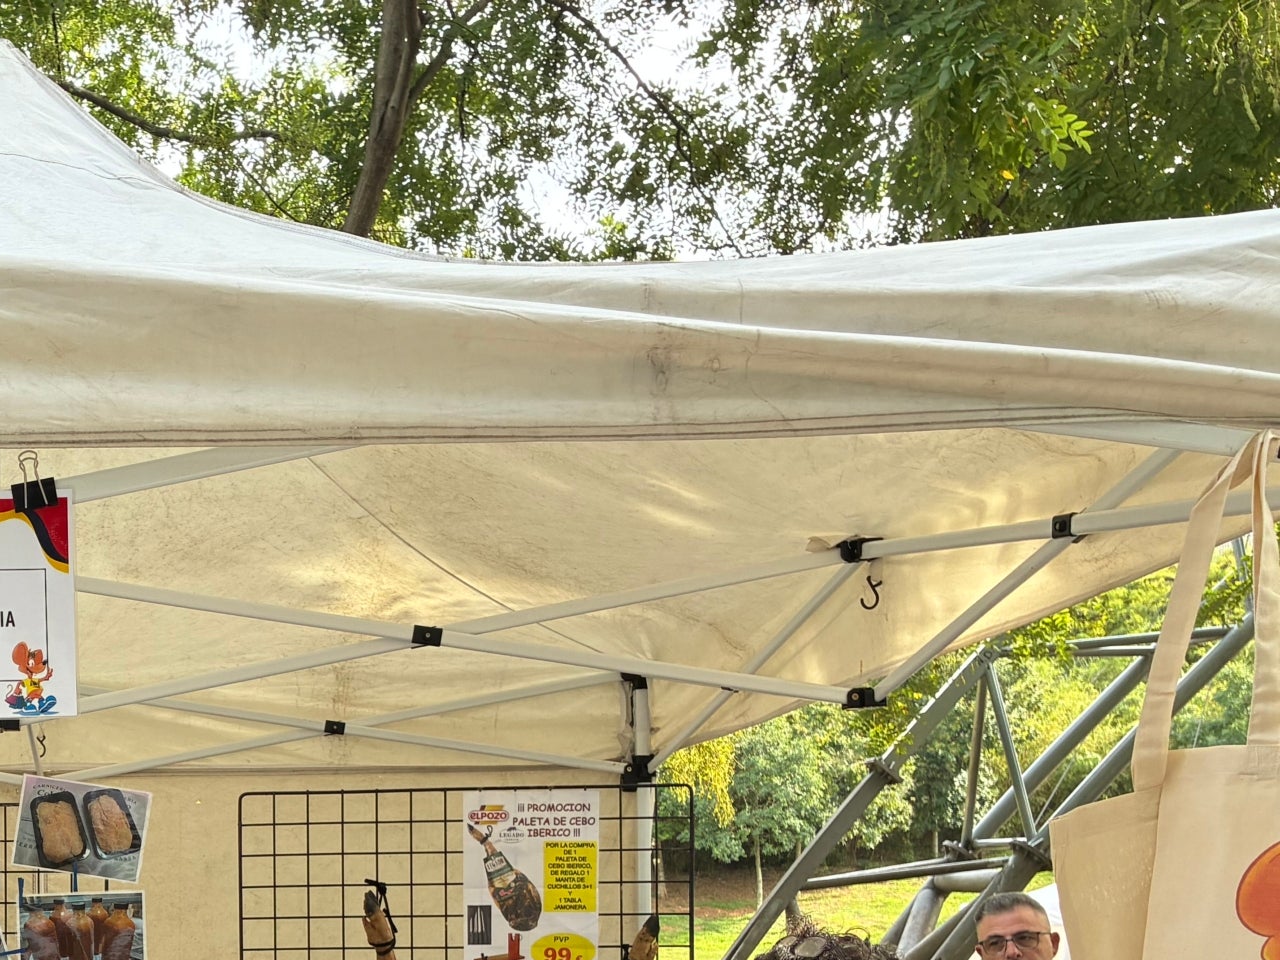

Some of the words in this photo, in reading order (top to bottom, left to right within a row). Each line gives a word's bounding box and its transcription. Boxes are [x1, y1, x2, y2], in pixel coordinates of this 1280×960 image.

[526, 803, 592, 813] PROMOCION
[512, 816, 551, 826] PALETA
[553, 816, 567, 826] DE
[569, 816, 596, 826] CEBO
[527, 828, 571, 838] IBERICO
[553, 935, 570, 943] PVP
